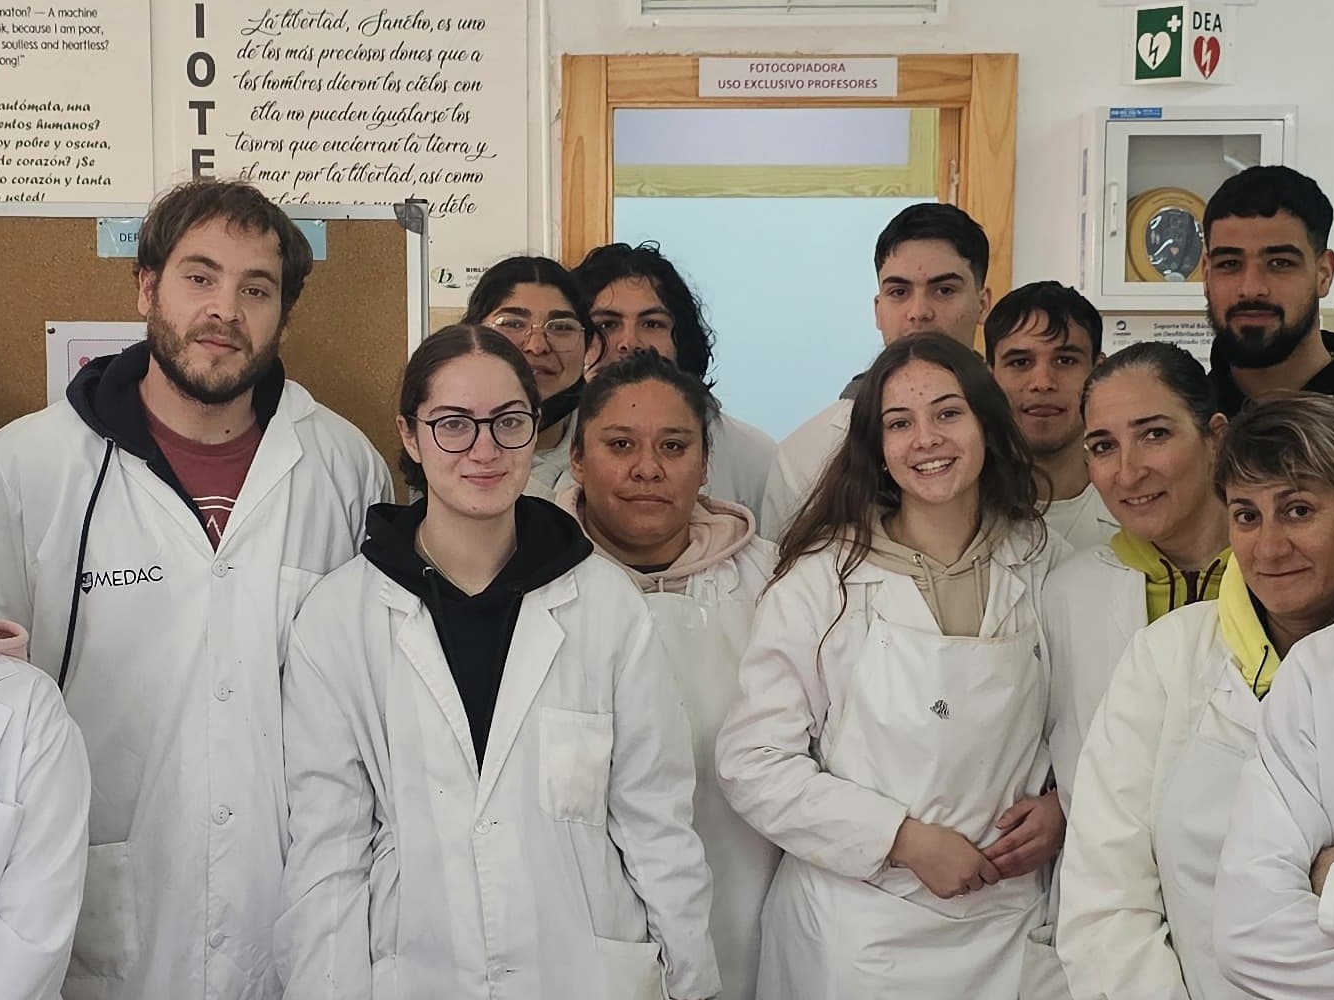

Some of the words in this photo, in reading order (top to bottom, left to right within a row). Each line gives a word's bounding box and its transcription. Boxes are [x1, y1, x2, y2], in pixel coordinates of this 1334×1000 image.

[58, 7, 98, 18] machine
[357, 8, 434, 38] Sancho,
[457, 18, 487, 32] uno
[1192, 10, 1223, 33] DEA
[12, 23, 52, 34] because
[78, 25, 104, 37] poor,
[1, 39, 38, 50] soulless
[40, 39, 59, 50] and
[62, 39, 109, 51] heartless?
[285, 44, 315, 62] más
[316, 43, 386, 70] preciosos
[389, 40, 433, 63] dones
[437, 49, 468, 70] que
[749, 62, 846, 73] FOTOCOPIADORA
[326, 70, 378, 92] dieron
[405, 71, 448, 94] cielos
[453, 79, 483, 93] con
[718, 79, 741, 89] USO
[743, 79, 805, 89] EXCLUSIVO
[807, 79, 878, 89] PROFESORES
[66, 102, 91, 112] una
[250, 99, 283, 122] ella
[307, 100, 369, 131] pueden
[35, 118, 100, 132] humanos?
[15, 136, 50, 151] pobre
[65, 139, 111, 151] oscura,
[288, 139, 320, 161] que
[322, 134, 400, 154] encierran
[16, 154, 72, 168] corazón?
[11, 172, 61, 186] corazón
[76, 173, 112, 186] tanta
[258, 169, 291, 183] mar
[444, 171, 485, 184] como
[438, 192, 478, 214] debe
[94, 563, 164, 588] MEDAC
